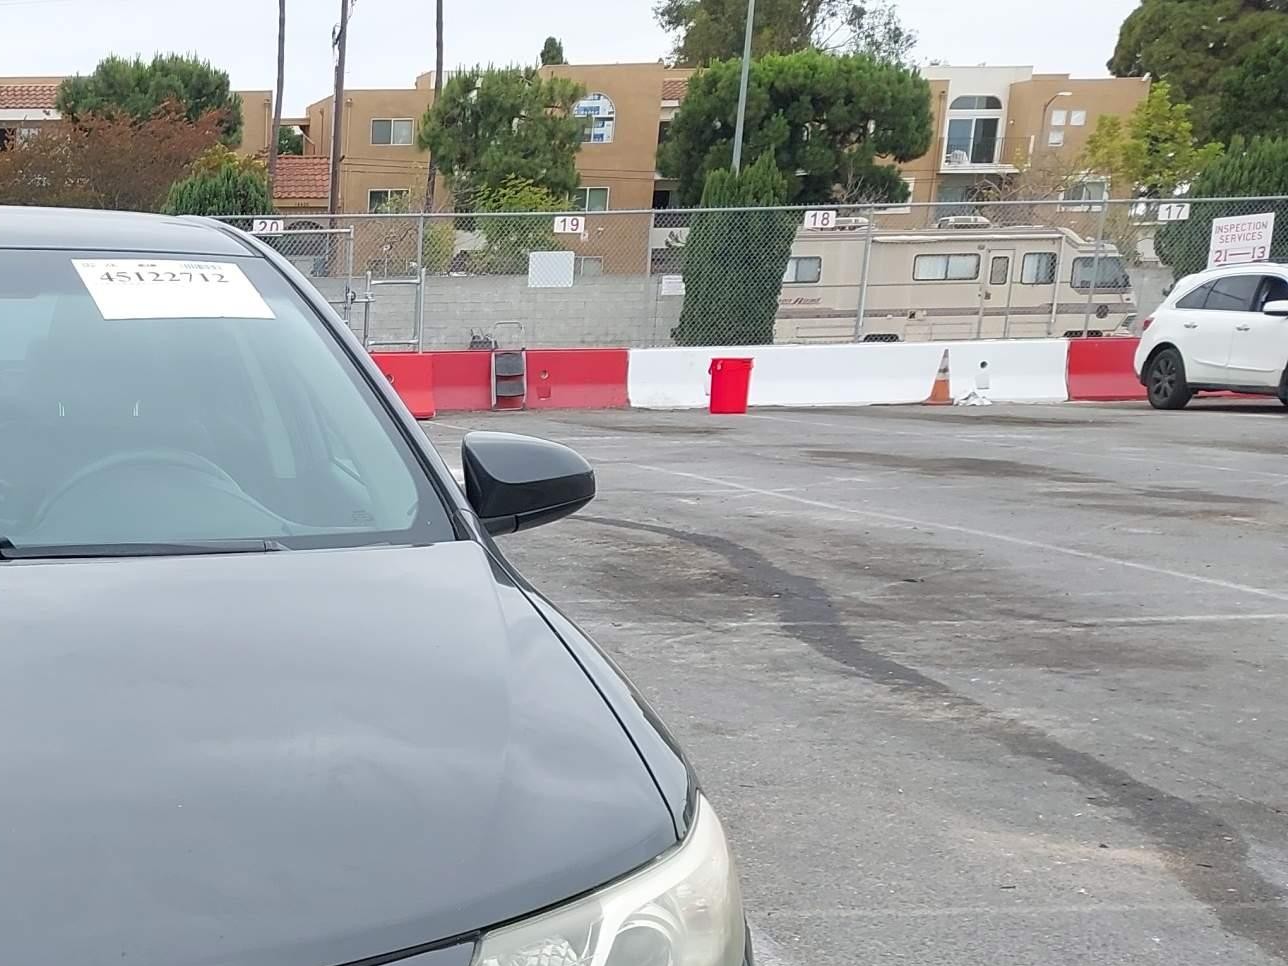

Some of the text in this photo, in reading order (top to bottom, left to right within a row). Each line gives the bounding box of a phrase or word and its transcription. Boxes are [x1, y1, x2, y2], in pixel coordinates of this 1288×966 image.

[811, 211, 829, 226] 18
[1166, 204, 1185, 219] 17
[258, 220, 279, 232] 20
[560, 217, 579, 231] 19
[1215, 221, 1268, 235] INSPECTION
[1219, 231, 1263, 243] SERVICES
[99, 271, 230, 284] 45122712
